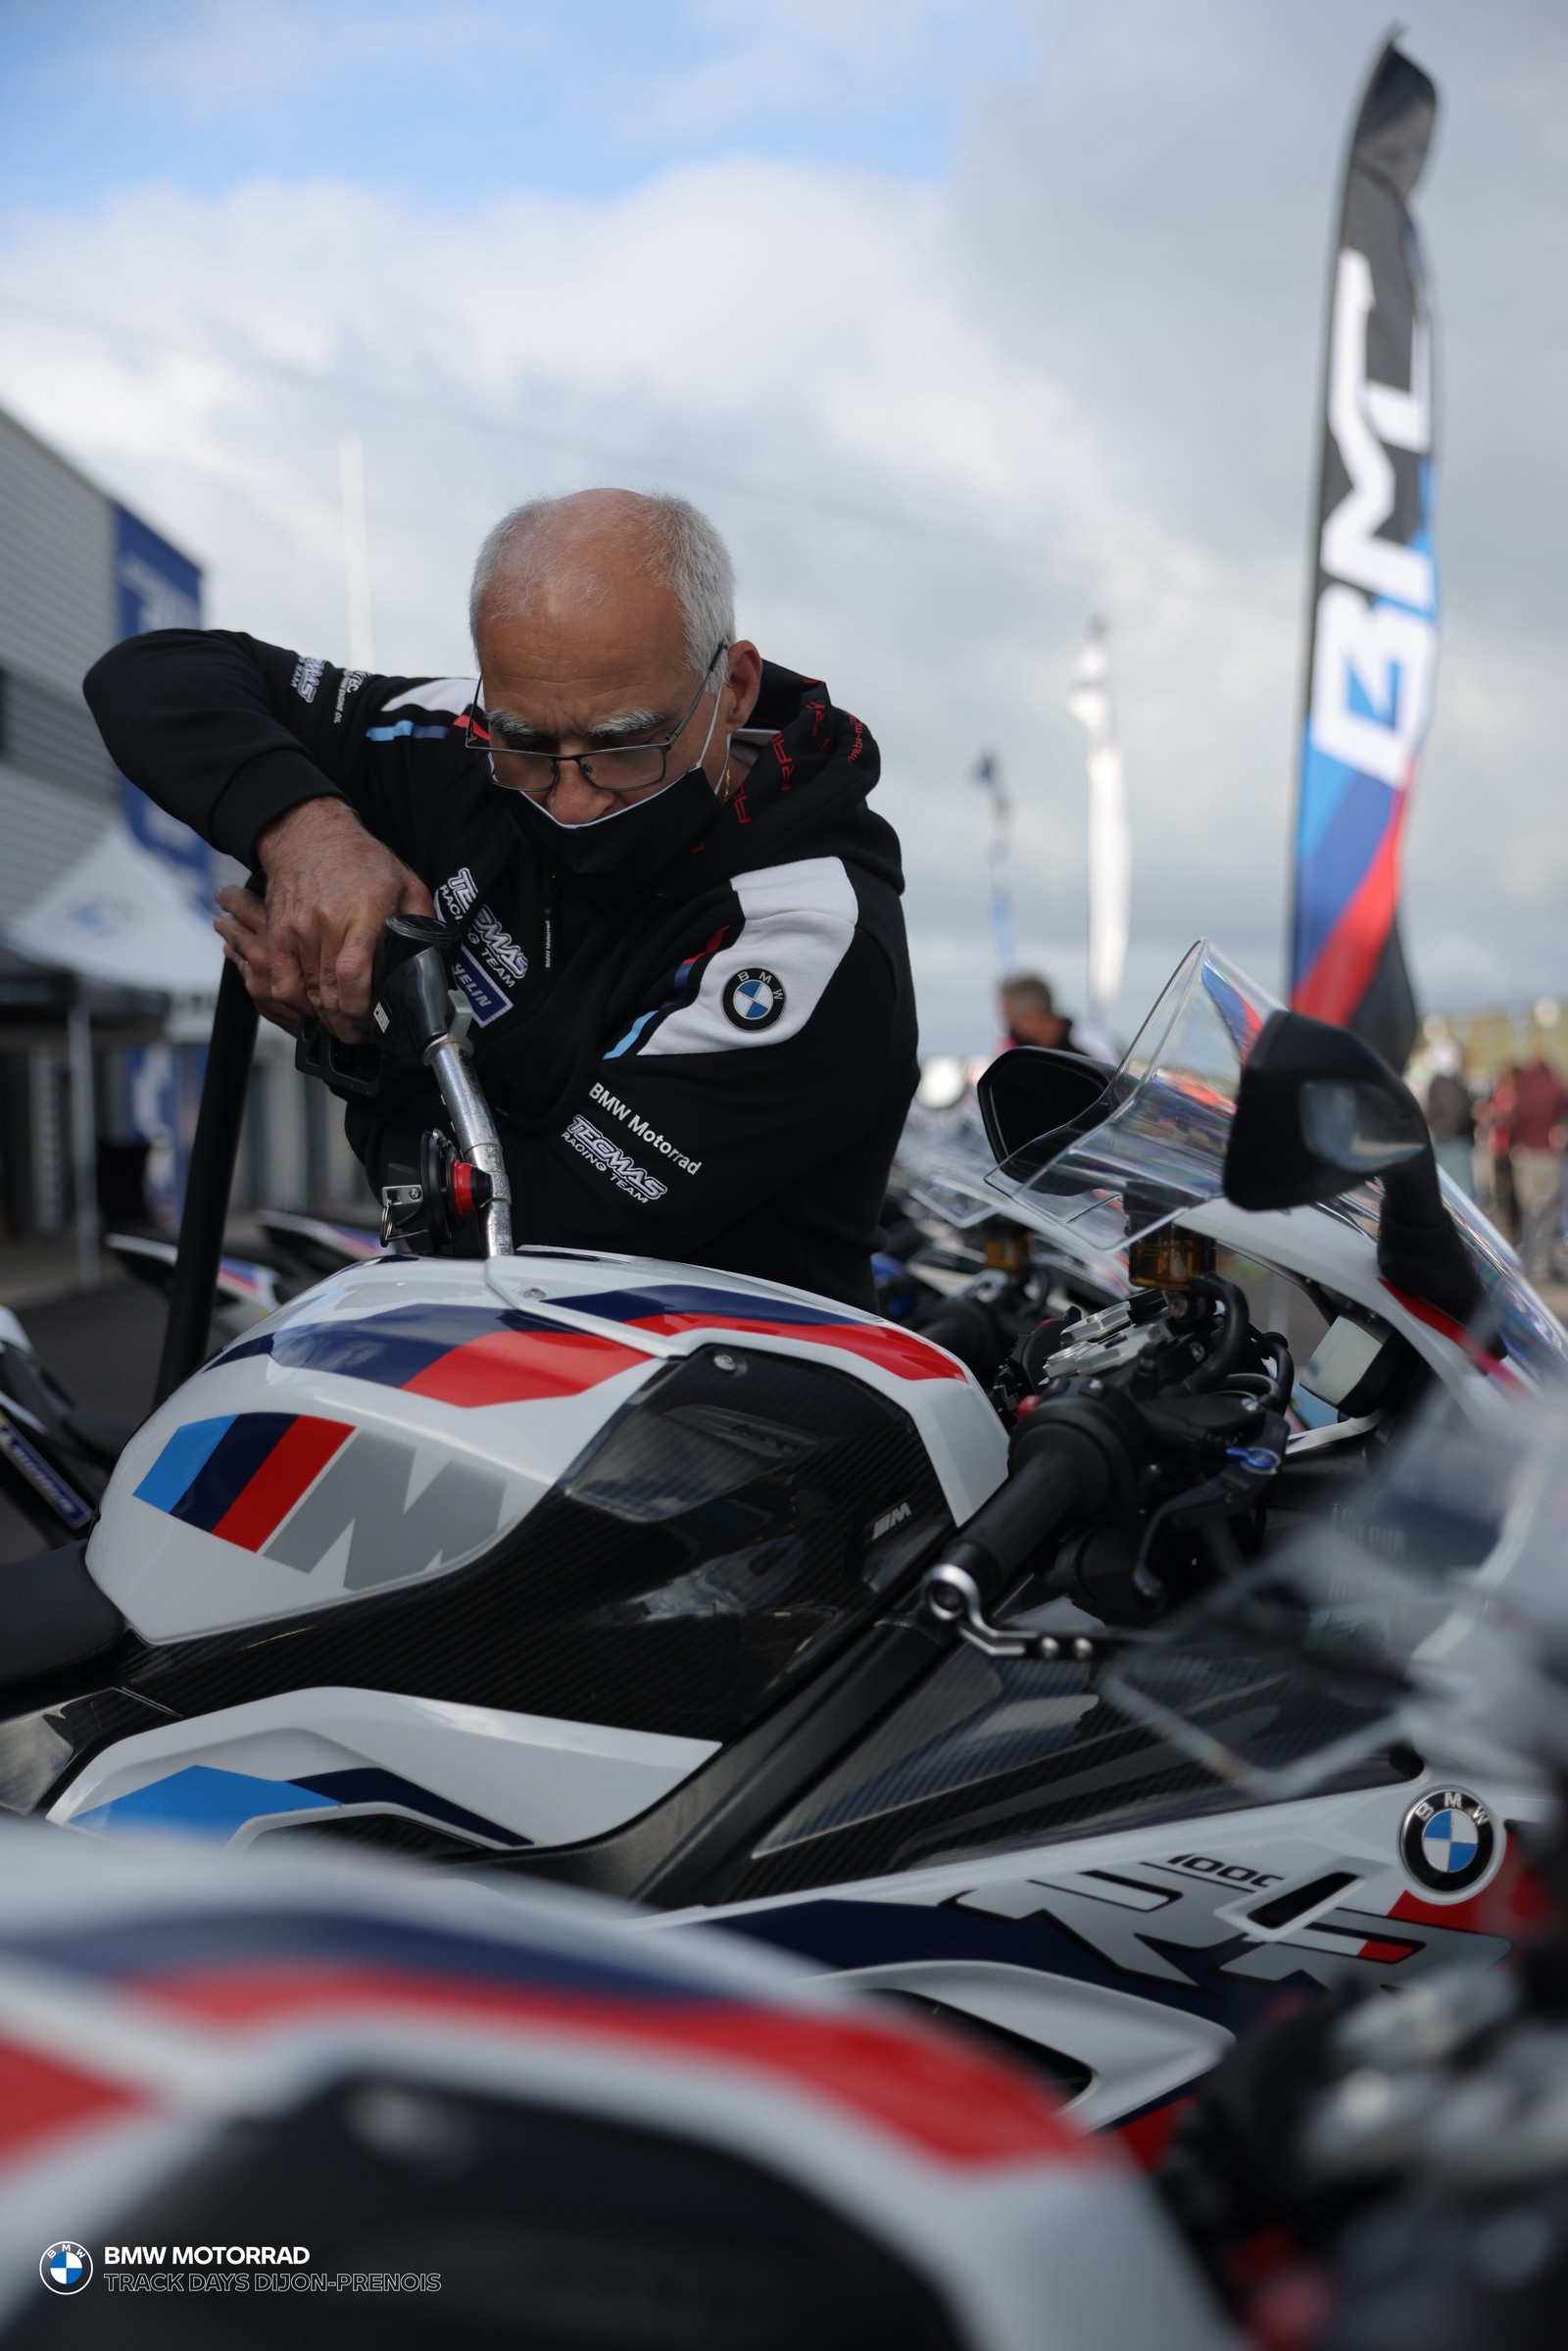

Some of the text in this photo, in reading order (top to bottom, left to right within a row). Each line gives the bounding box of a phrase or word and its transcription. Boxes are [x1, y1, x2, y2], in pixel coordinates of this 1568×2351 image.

[440, 884, 515, 988] RACIG TEAM
[454, 962, 492, 1007] HELIN
[738, 971, 784, 1000] BMW
[561, 1131, 649, 1203] RACING TEAM
[566, 1113, 668, 1200] TEGMAS
[588, 1082, 703, 1175] BMW Motorrad
[262, 1431, 508, 1591] M
[1414, 1792, 1489, 1827] BMW
